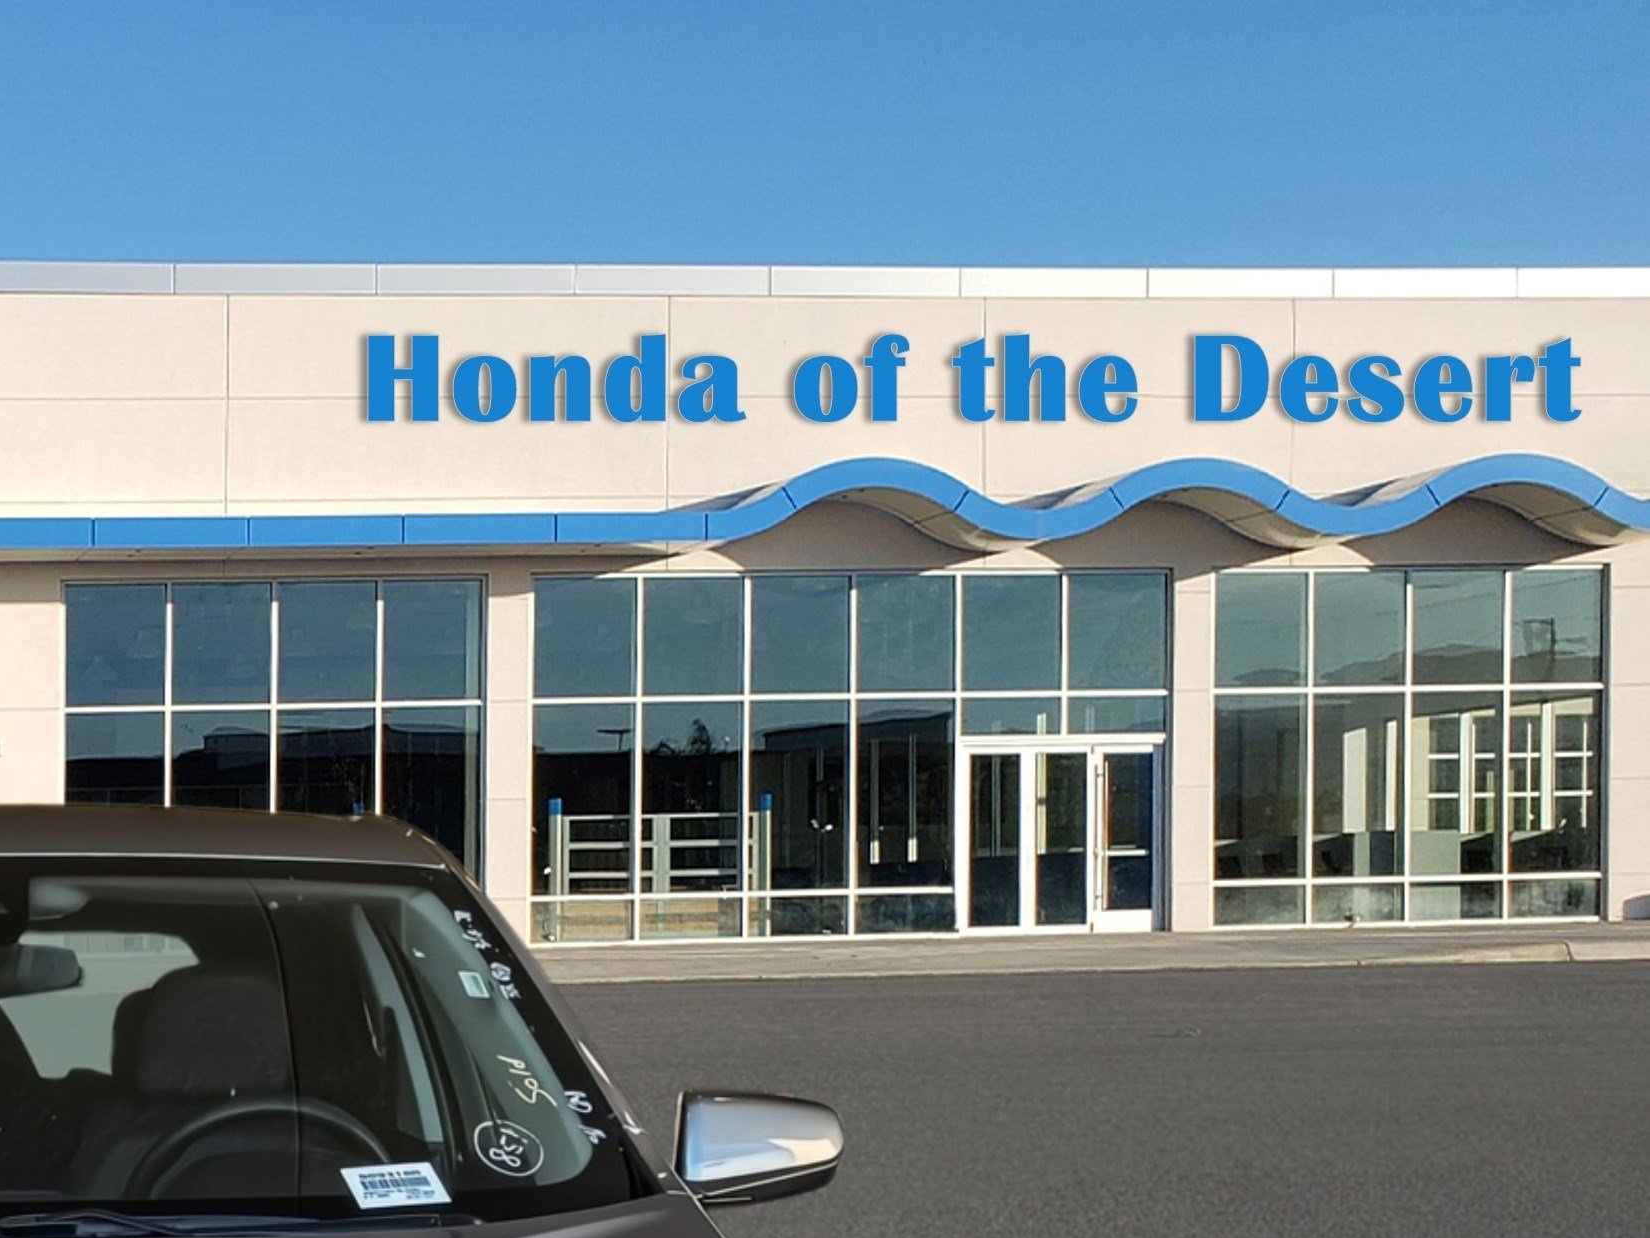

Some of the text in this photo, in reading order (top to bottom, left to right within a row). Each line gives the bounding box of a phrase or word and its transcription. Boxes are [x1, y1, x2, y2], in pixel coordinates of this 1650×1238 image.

[367, 333, 1583, 424] Honda of the Desert
